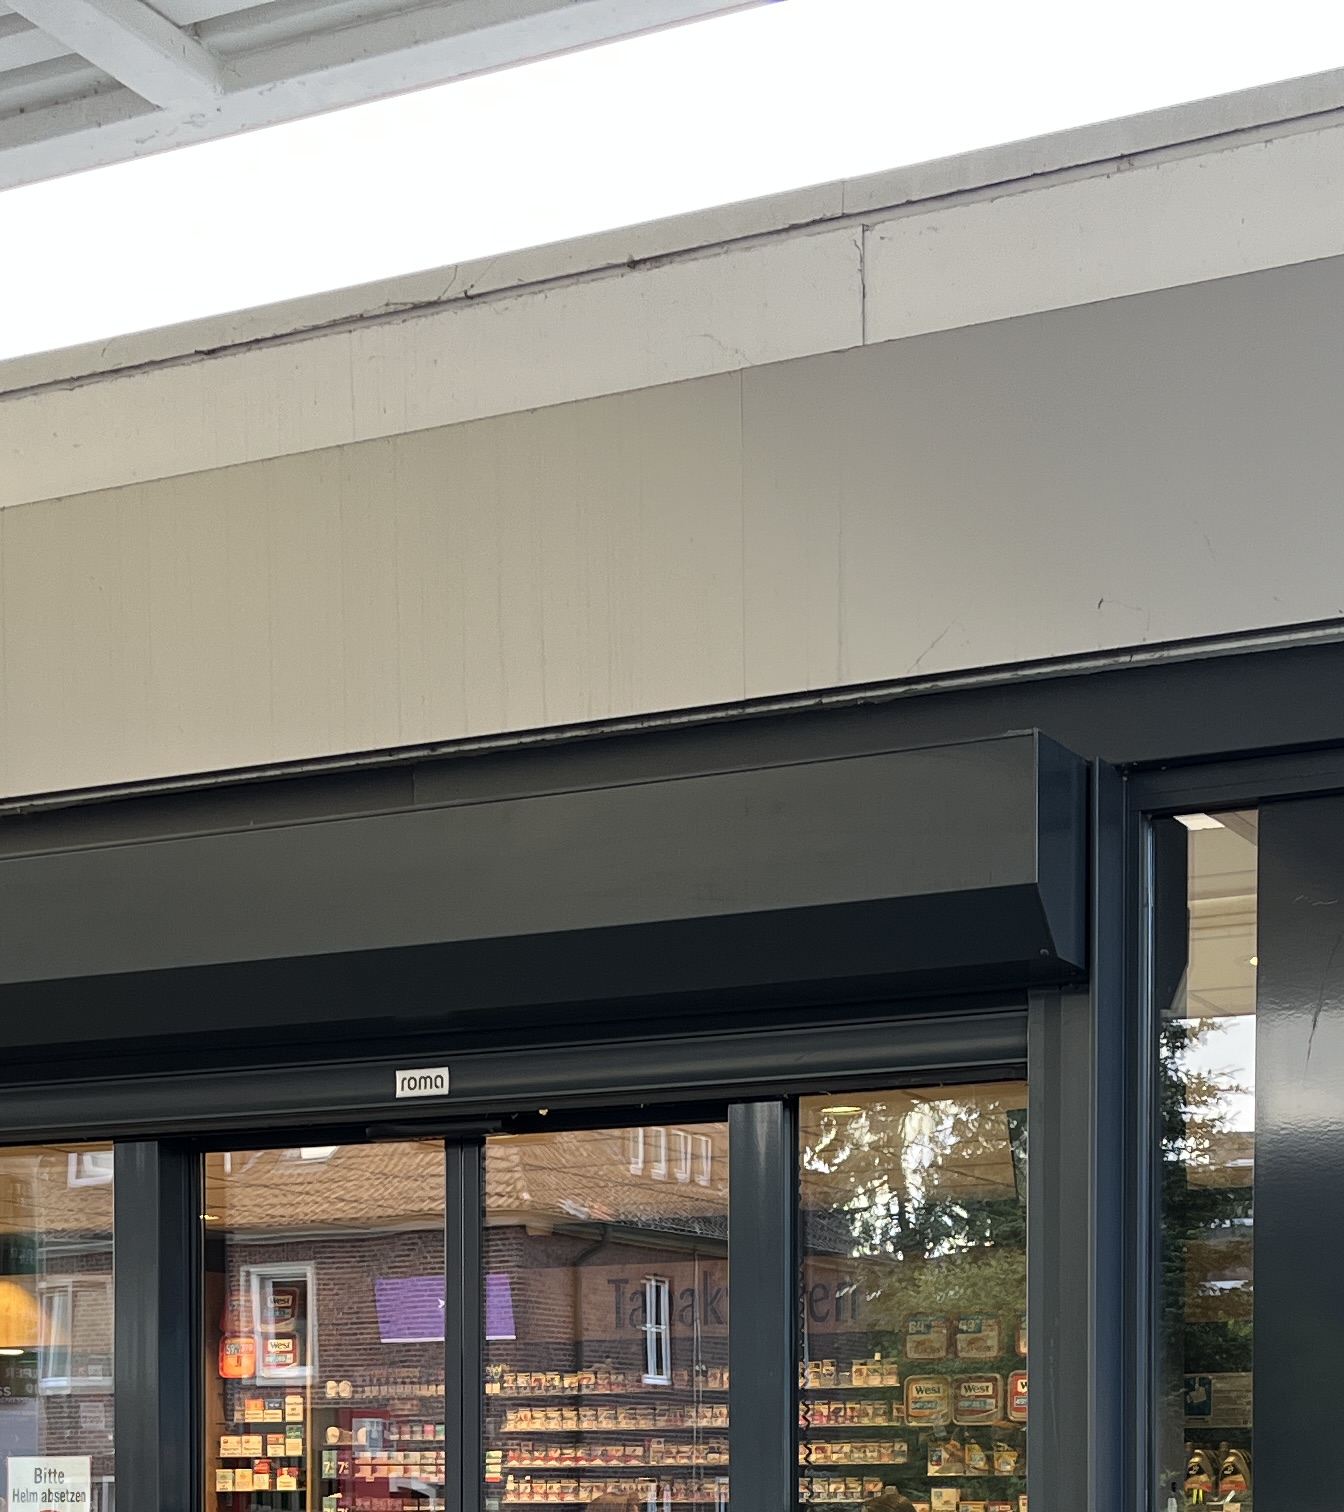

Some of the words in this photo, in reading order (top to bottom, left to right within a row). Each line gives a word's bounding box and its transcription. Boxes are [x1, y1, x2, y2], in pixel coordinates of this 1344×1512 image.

[399, 1071, 445, 1092] roma
[270, 1342, 291, 1350] West
[914, 1385, 942, 1395] West
[963, 1384, 991, 1394] West
[34, 1467, 65, 1484] Bitte
[12, 1488, 38, 1503] Helm
[41, 1488, 86, 1503] absetzen
